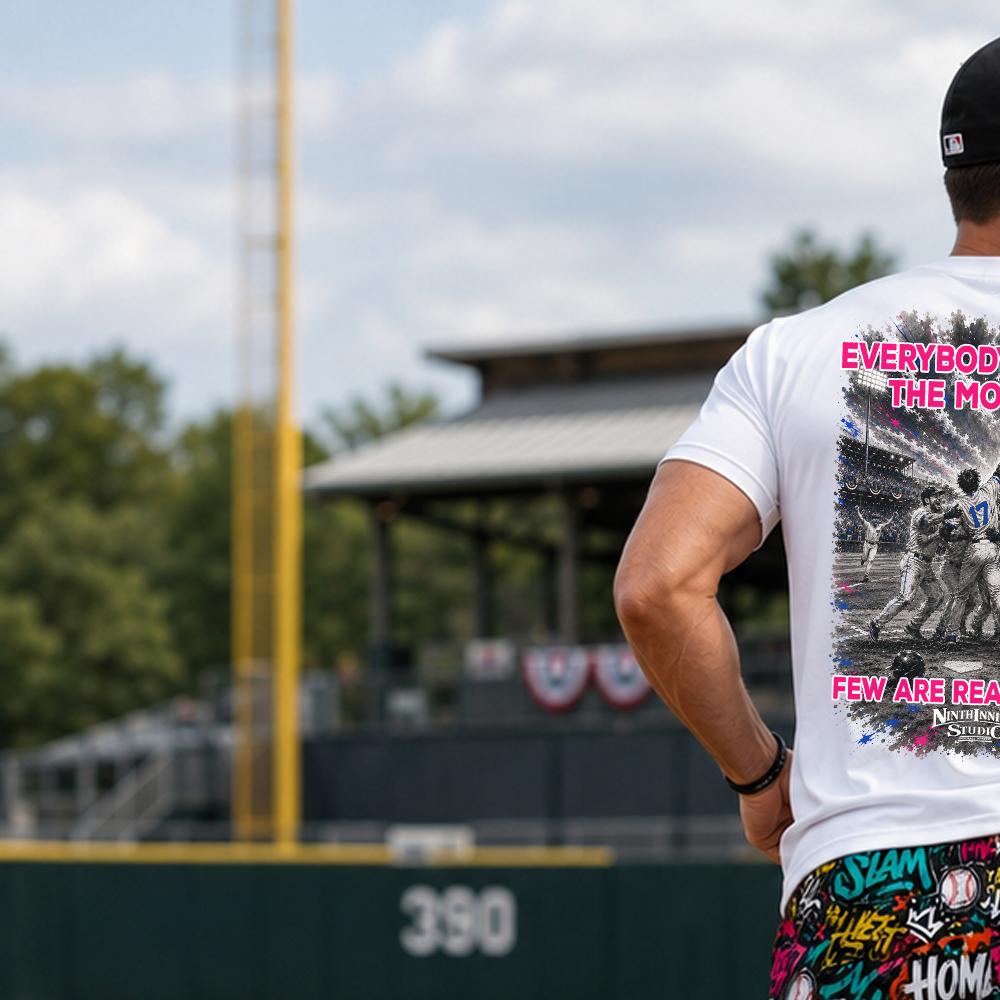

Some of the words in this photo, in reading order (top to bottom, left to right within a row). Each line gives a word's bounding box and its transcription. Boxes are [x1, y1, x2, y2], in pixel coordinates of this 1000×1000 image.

[887, 378, 946, 408] THE
[969, 501, 989, 529] 17
[831, 676, 887, 702] FEW
[893, 678, 946, 704] ARE
[833, 848, 933, 900] SLAM
[400, 884, 518, 957] 390
